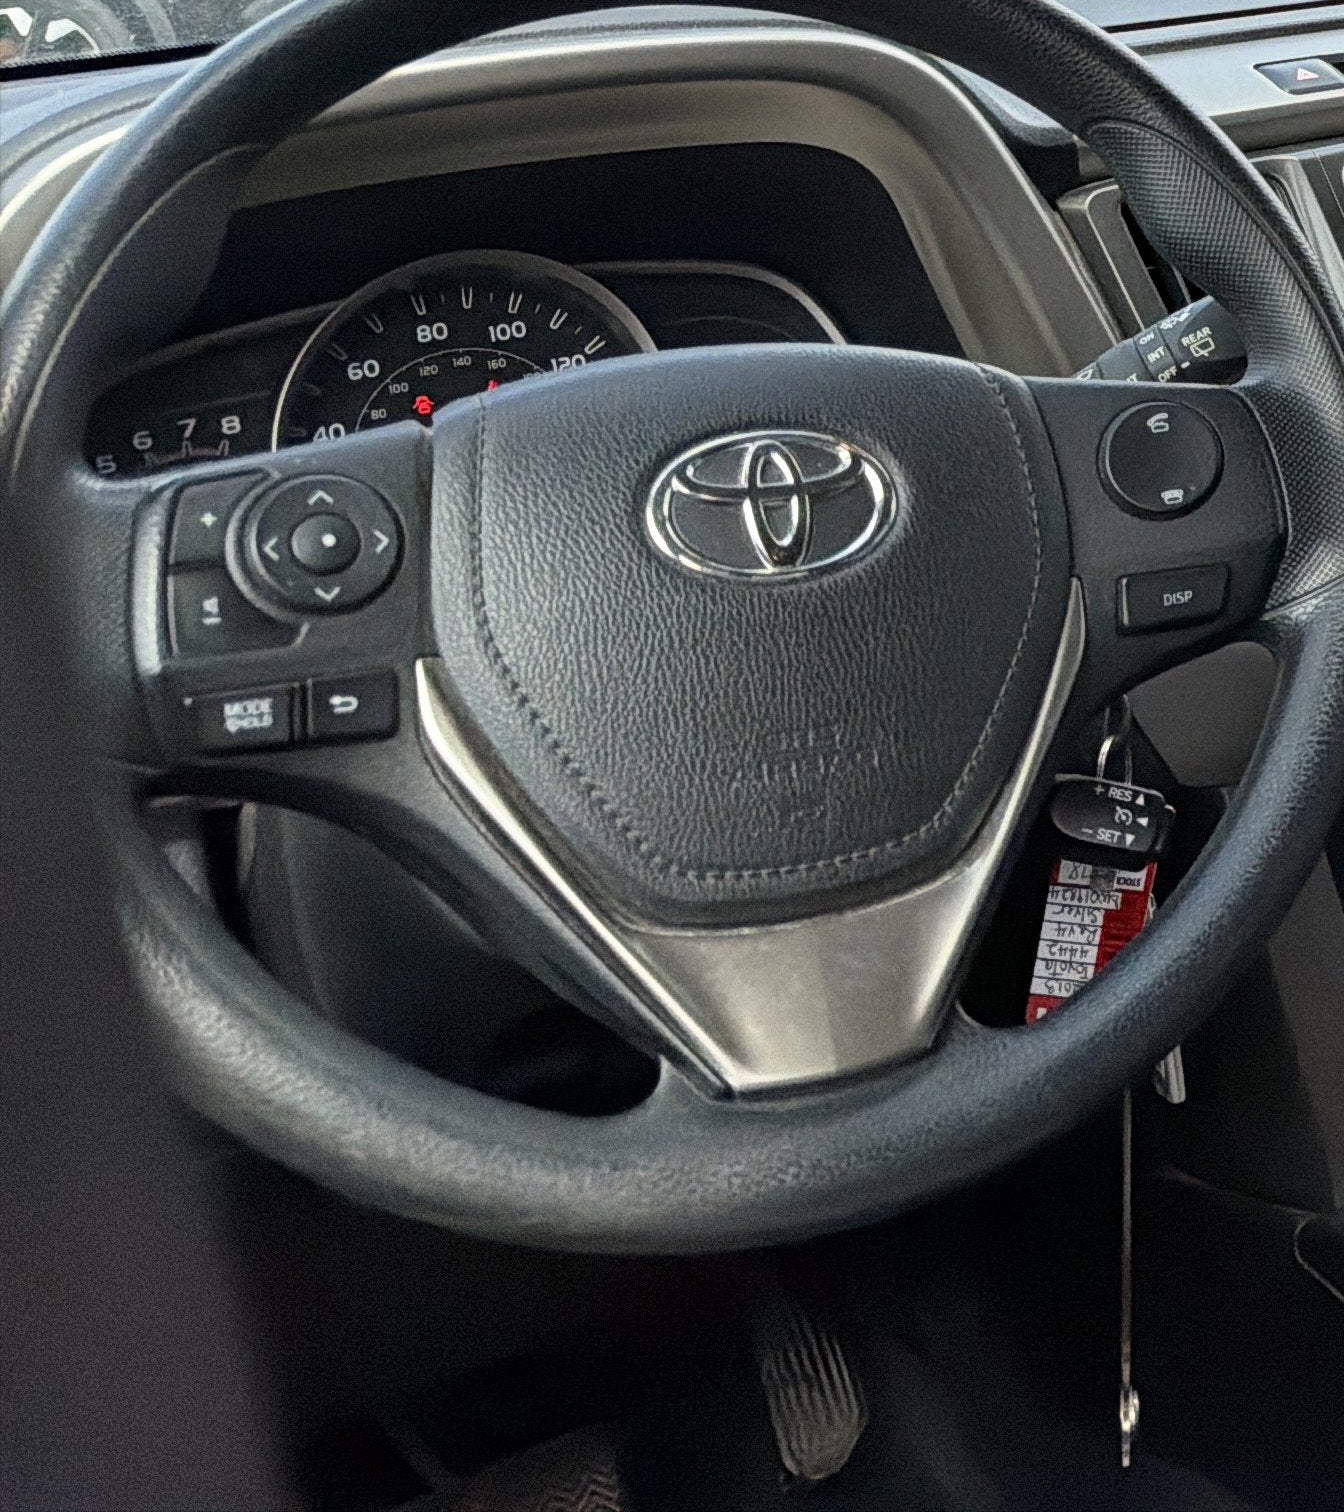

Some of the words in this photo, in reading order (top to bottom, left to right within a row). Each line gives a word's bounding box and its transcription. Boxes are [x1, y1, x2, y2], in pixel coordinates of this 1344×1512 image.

[416, 322, 448, 343] 80
[488, 321, 527, 343] 100
[1139, 331, 1156, 345] ON
[1181, 326, 1212, 348] REAR
[452, 356, 472, 368] 140
[1147, 345, 1166, 363] INT
[347, 359, 380, 381] 60
[419, 364, 439, 377] 120
[487, 358, 507, 371] 160
[1157, 365, 1178, 383] OFF
[388, 382, 409, 394] 100
[370, 408, 388, 420] 80
[176, 418, 198, 438] 7
[221, 414, 242, 435] 8
[312, 422, 347, 443] 40
[132, 431, 153, 451] 6
[1162, 591, 1194, 607] DISP
[1108, 787, 1133, 802] RES
[1096, 828, 1122, 843] SET
